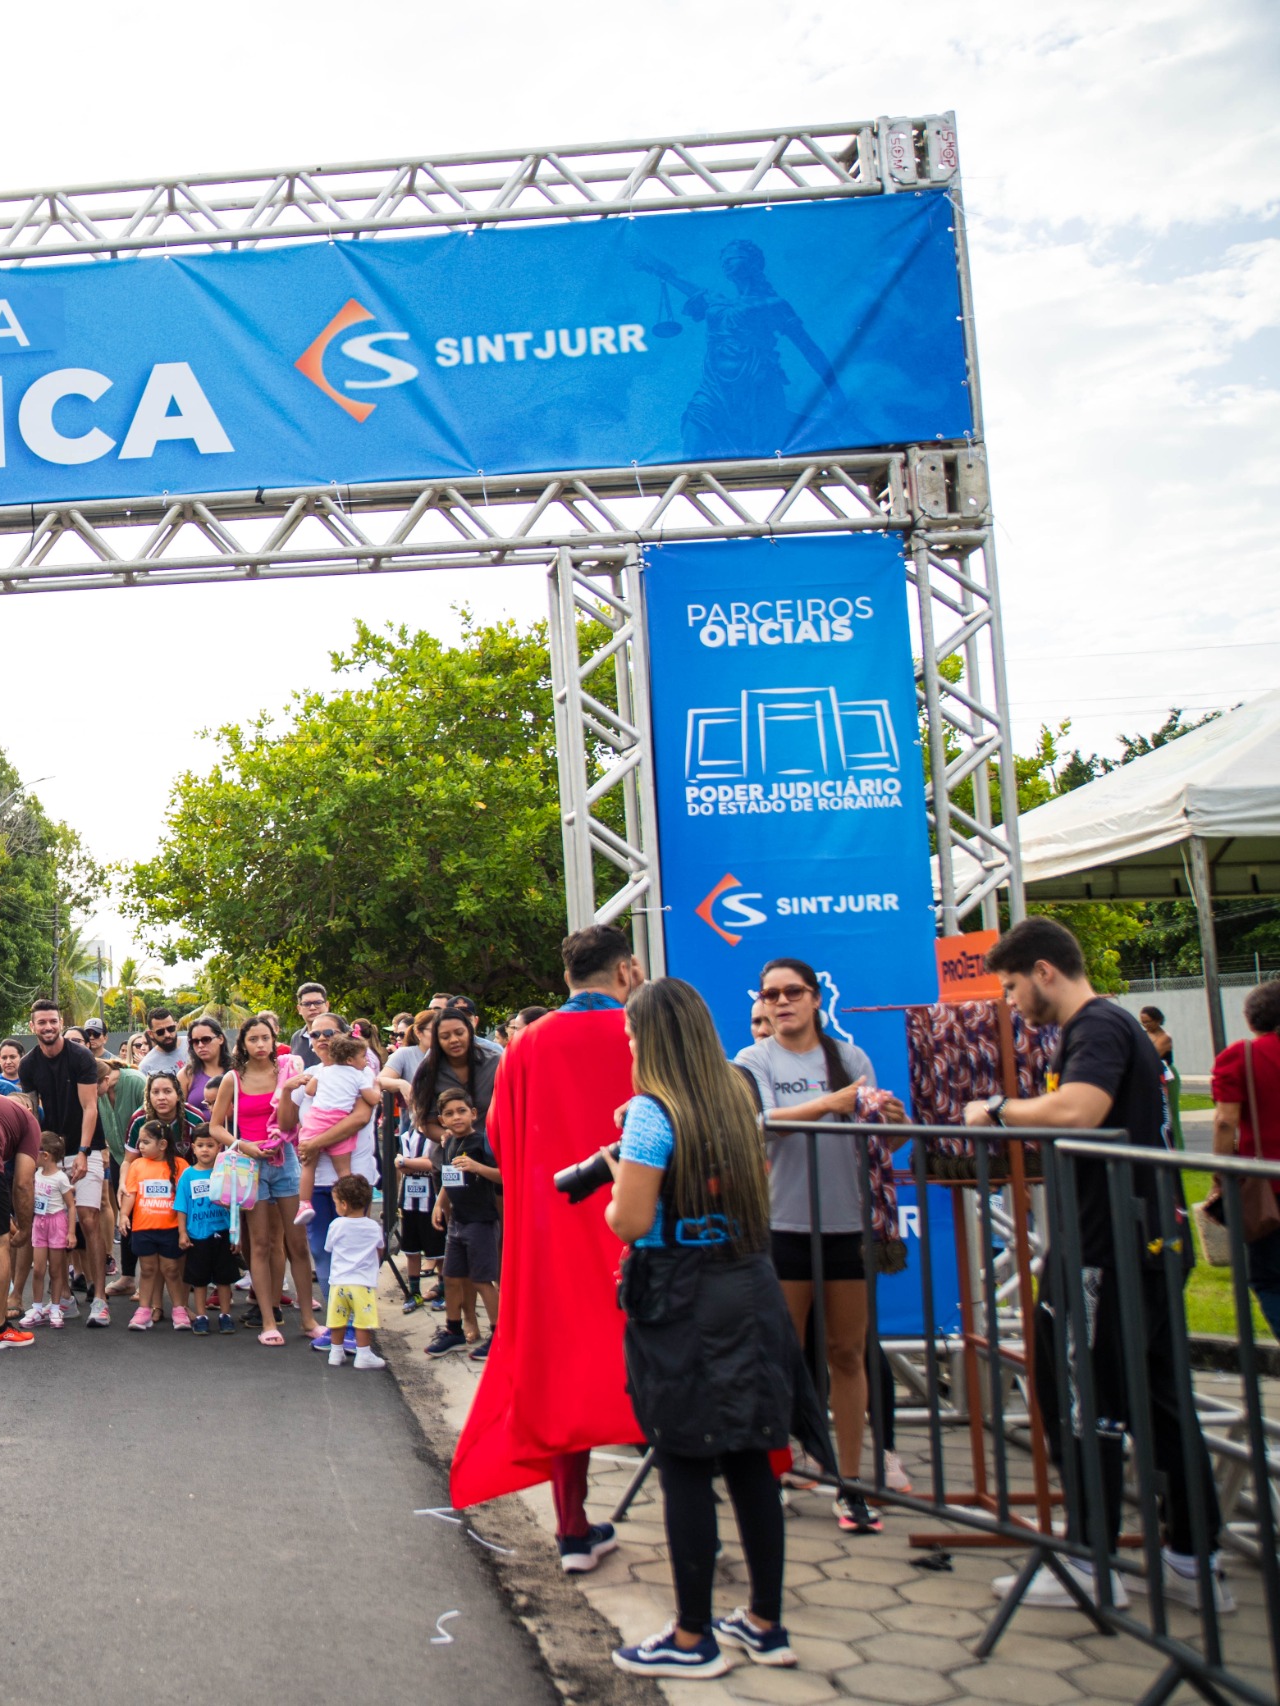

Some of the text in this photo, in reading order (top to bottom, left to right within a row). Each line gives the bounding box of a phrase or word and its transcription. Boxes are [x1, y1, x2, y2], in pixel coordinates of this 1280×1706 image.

[435, 323, 648, 367] SINTJURR
[687, 596, 874, 627] PARCEIROS
[699, 618, 854, 648] OFICIAIS
[685, 775, 902, 803] PODER JUDICIÁRIO
[687, 795, 903, 816] DO ESTADO DE RORAIMA
[776, 893, 900, 916] SINTJURR
